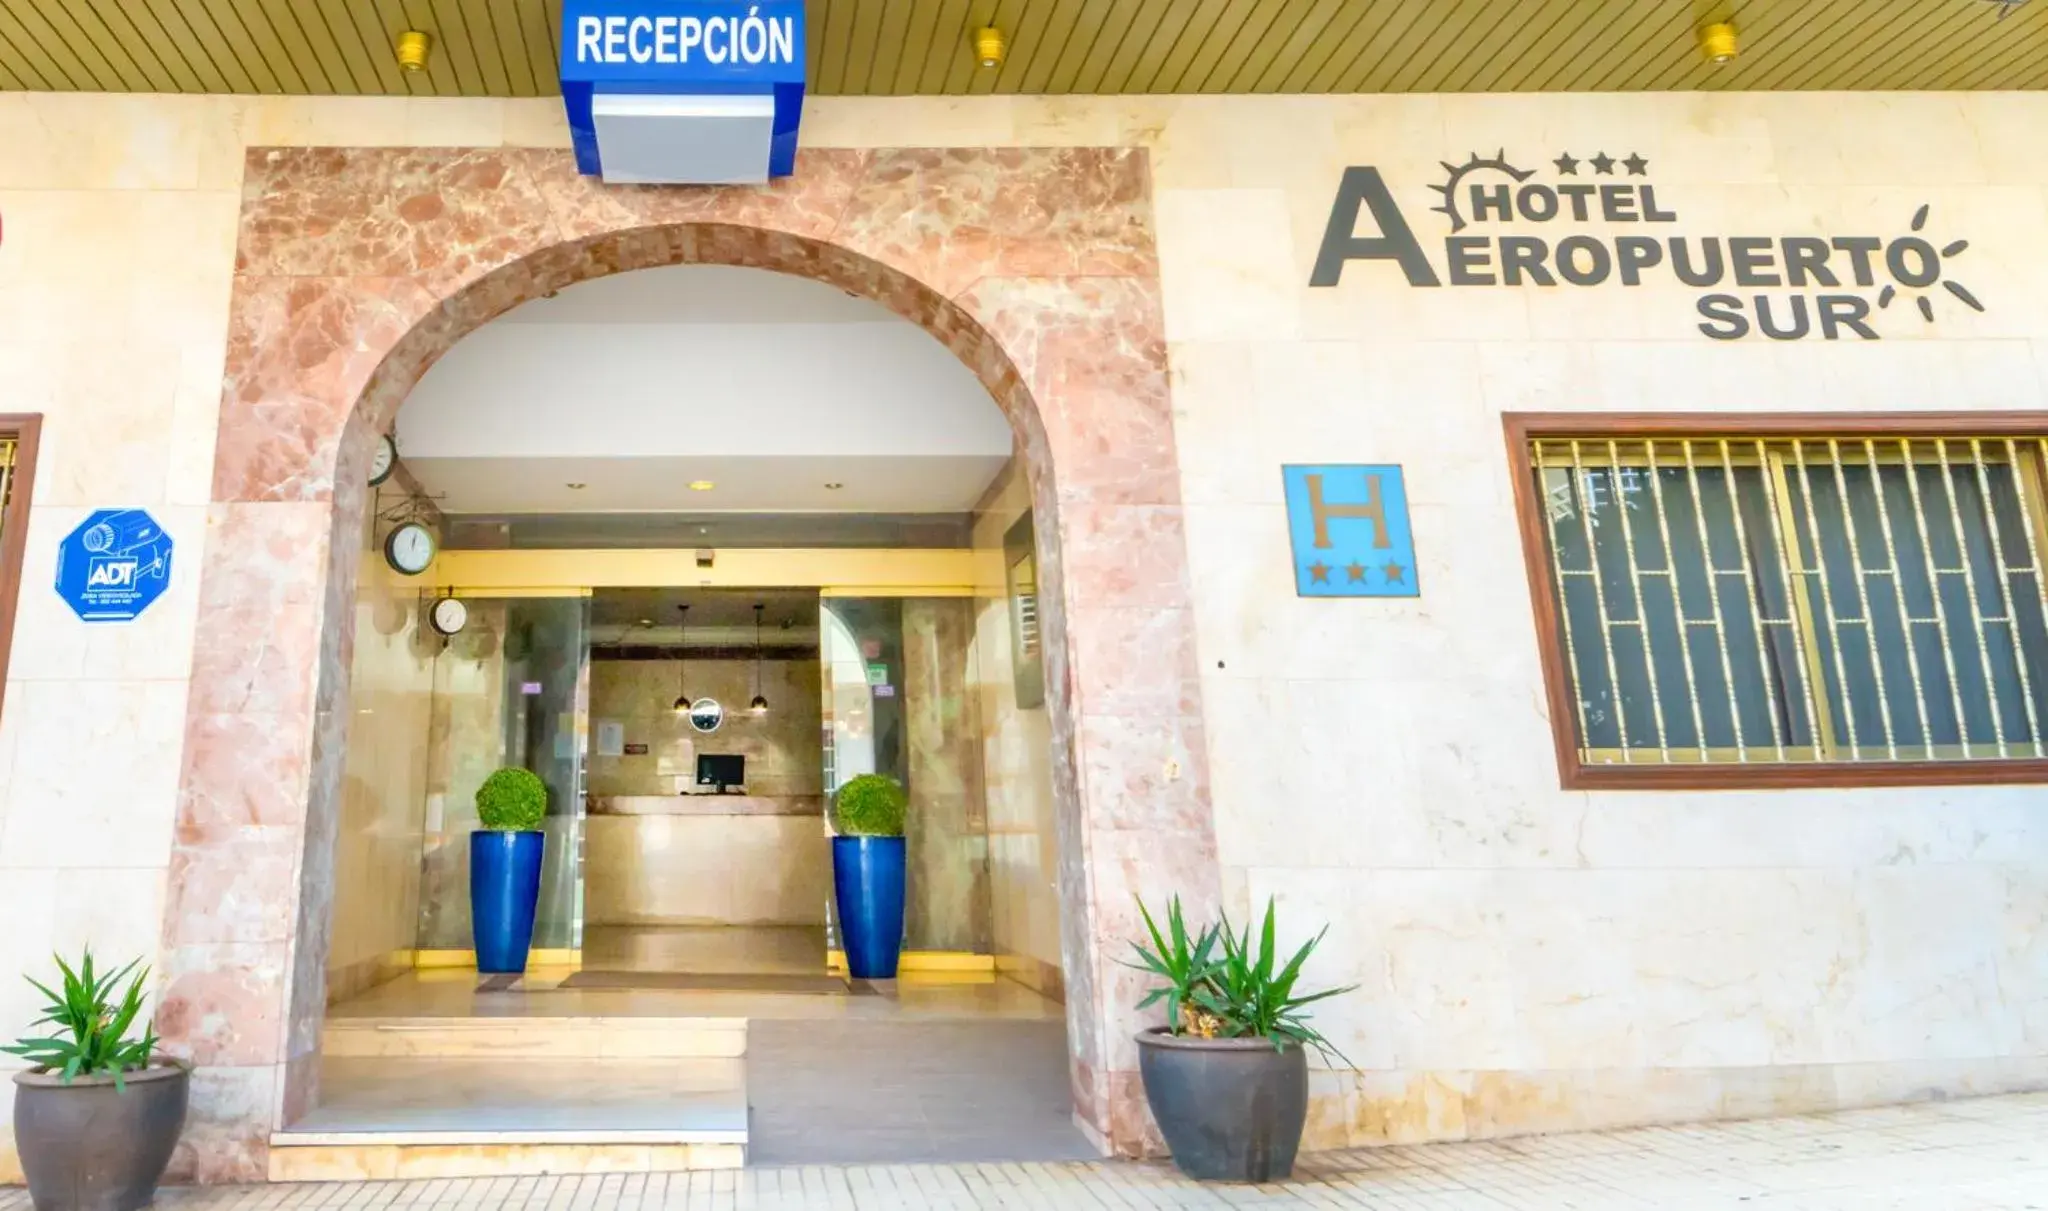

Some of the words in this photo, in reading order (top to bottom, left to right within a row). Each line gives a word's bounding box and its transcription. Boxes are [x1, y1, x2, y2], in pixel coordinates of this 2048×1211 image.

[577, 6, 793, 64] RECEPCIÓN
[1308, 165, 1941, 287] AEROPUERTO
[1470, 184, 1677, 222] HOTEL
[1697, 294, 1880, 340] SUR
[1304, 474, 1393, 549] H
[88, 562, 138, 585] ADT
